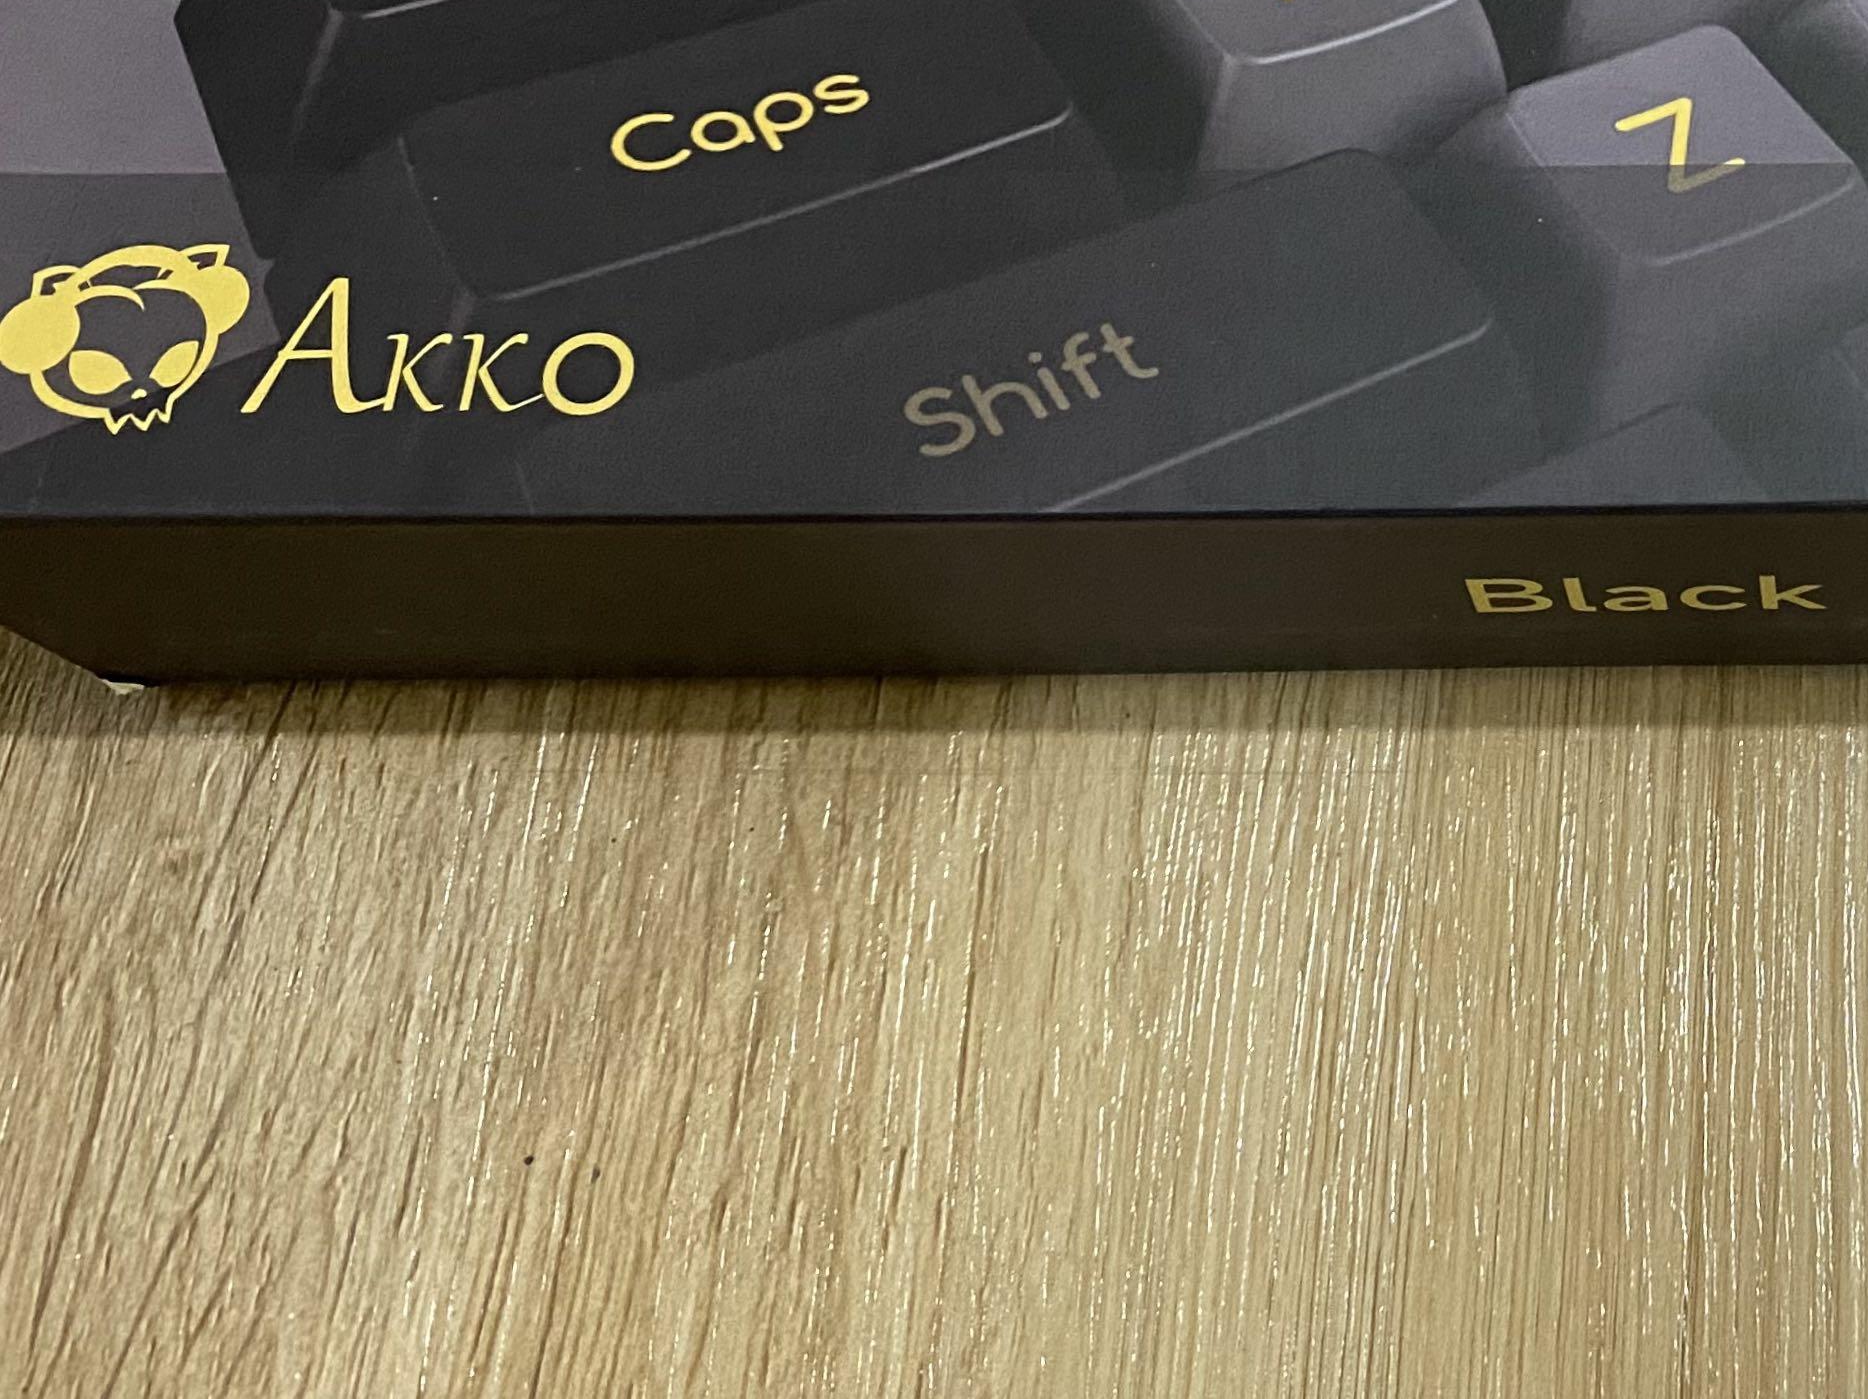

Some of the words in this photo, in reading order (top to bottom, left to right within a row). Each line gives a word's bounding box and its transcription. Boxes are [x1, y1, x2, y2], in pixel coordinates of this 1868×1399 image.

[610, 74, 869, 171] Caps
[1615, 96, 1745, 192] Z
[904, 322, 1159, 458] Shift
[1464, 575, 1827, 613] Black
